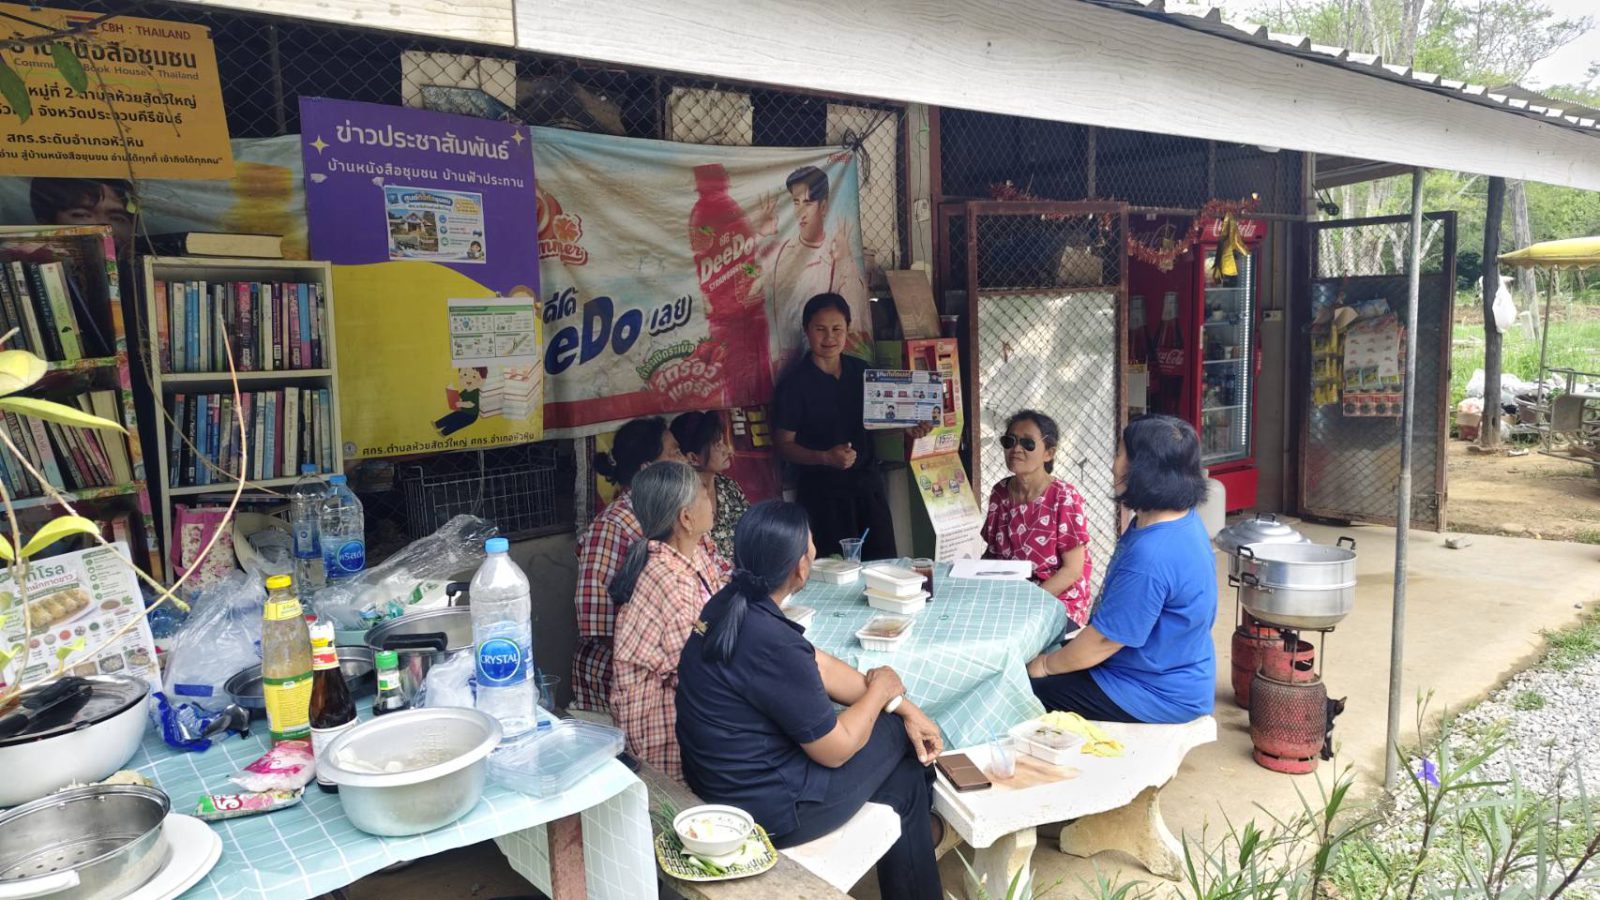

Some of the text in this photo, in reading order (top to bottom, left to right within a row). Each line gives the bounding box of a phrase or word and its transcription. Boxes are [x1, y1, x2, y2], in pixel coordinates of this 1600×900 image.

[101, 22, 124, 33] CBH
[136, 25, 191, 40] THAILAND
[83, 64, 110, 73] Book
[158, 69, 200, 80] Thailand
[64, 87, 73, 98] 2
[336, 120, 511, 160] ข่าวประชาสัมพันธ์
[328, 158, 525, 188] บ้านหนังสือชุมชน บ้านฟ้าประทาน
[700, 233, 754, 284] DeeDo
[650, 295, 690, 334] เลย
[480, 654, 518, 665] CRYSTAL
